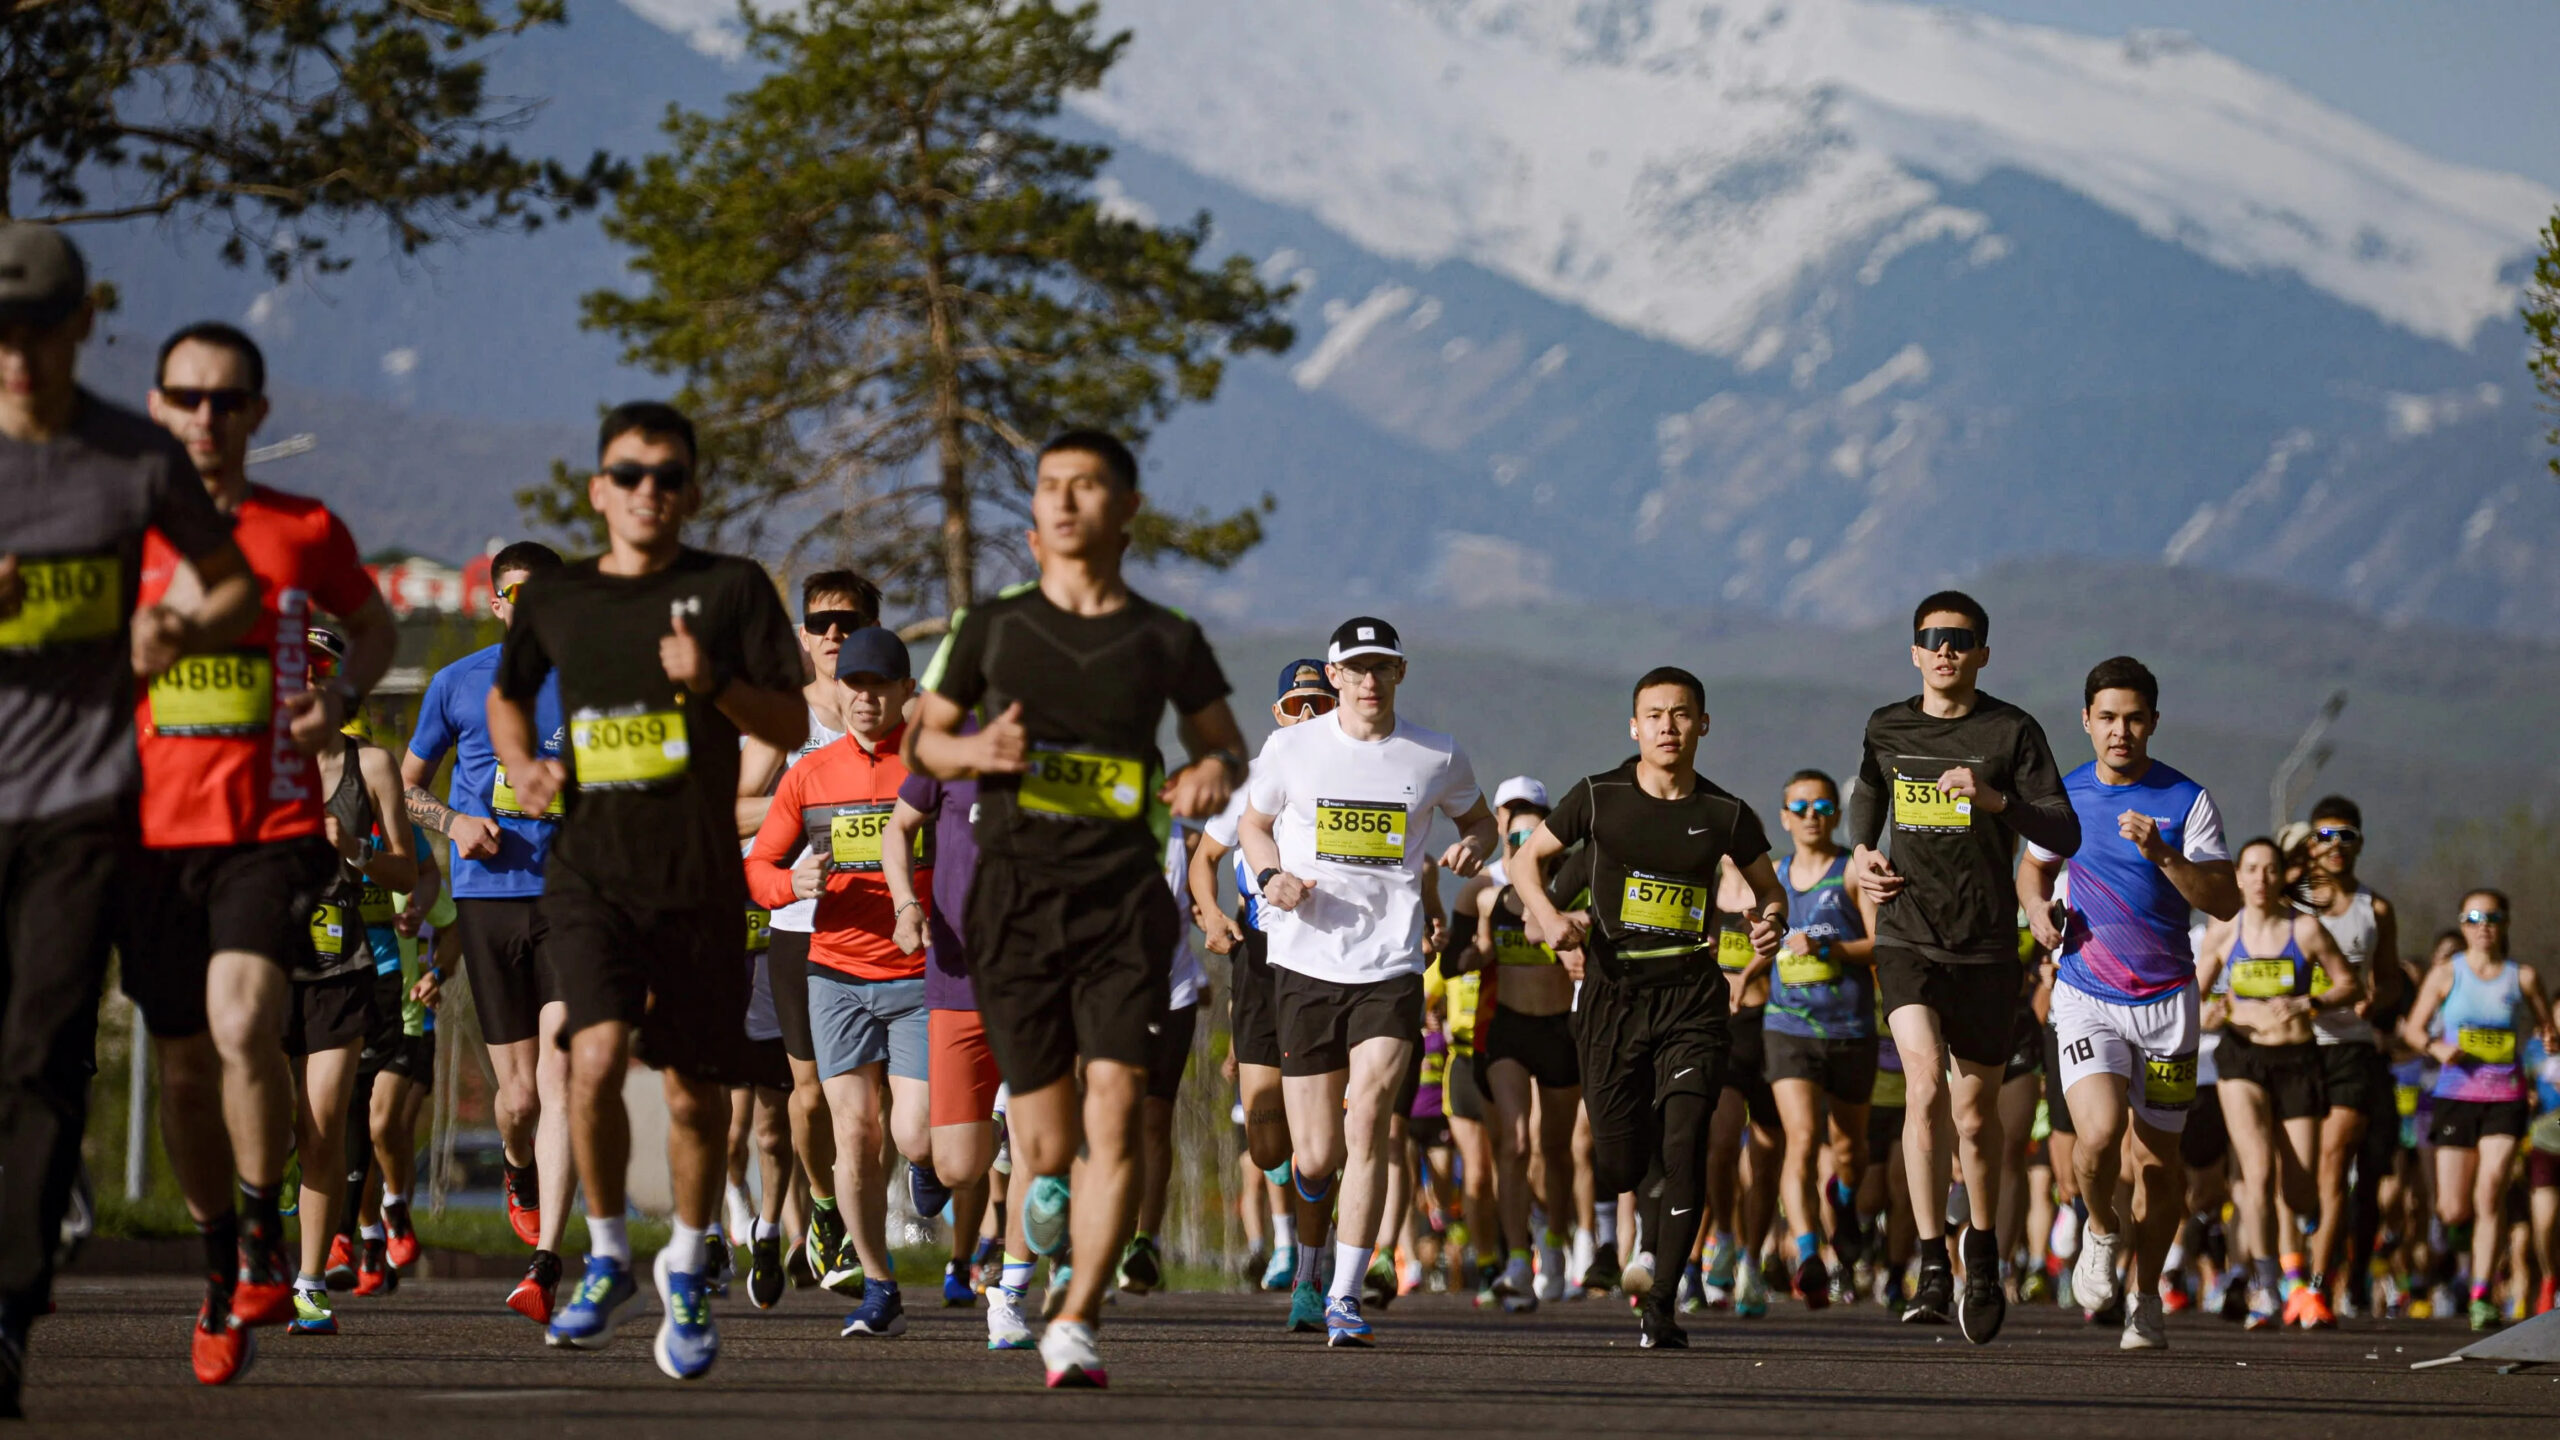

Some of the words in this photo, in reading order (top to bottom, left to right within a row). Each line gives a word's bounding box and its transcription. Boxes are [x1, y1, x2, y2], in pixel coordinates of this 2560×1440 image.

[168, 660, 255, 690] 4886
[586, 719, 666, 750] 6069
[1043, 755, 1122, 788] 6372
[834, 830, 841, 838] A
[1317, 821, 1324, 829] A
[1328, 811, 1392, 834] 3856
[1629, 889, 1636, 898] A
[1638, 882, 1693, 907] 5778
